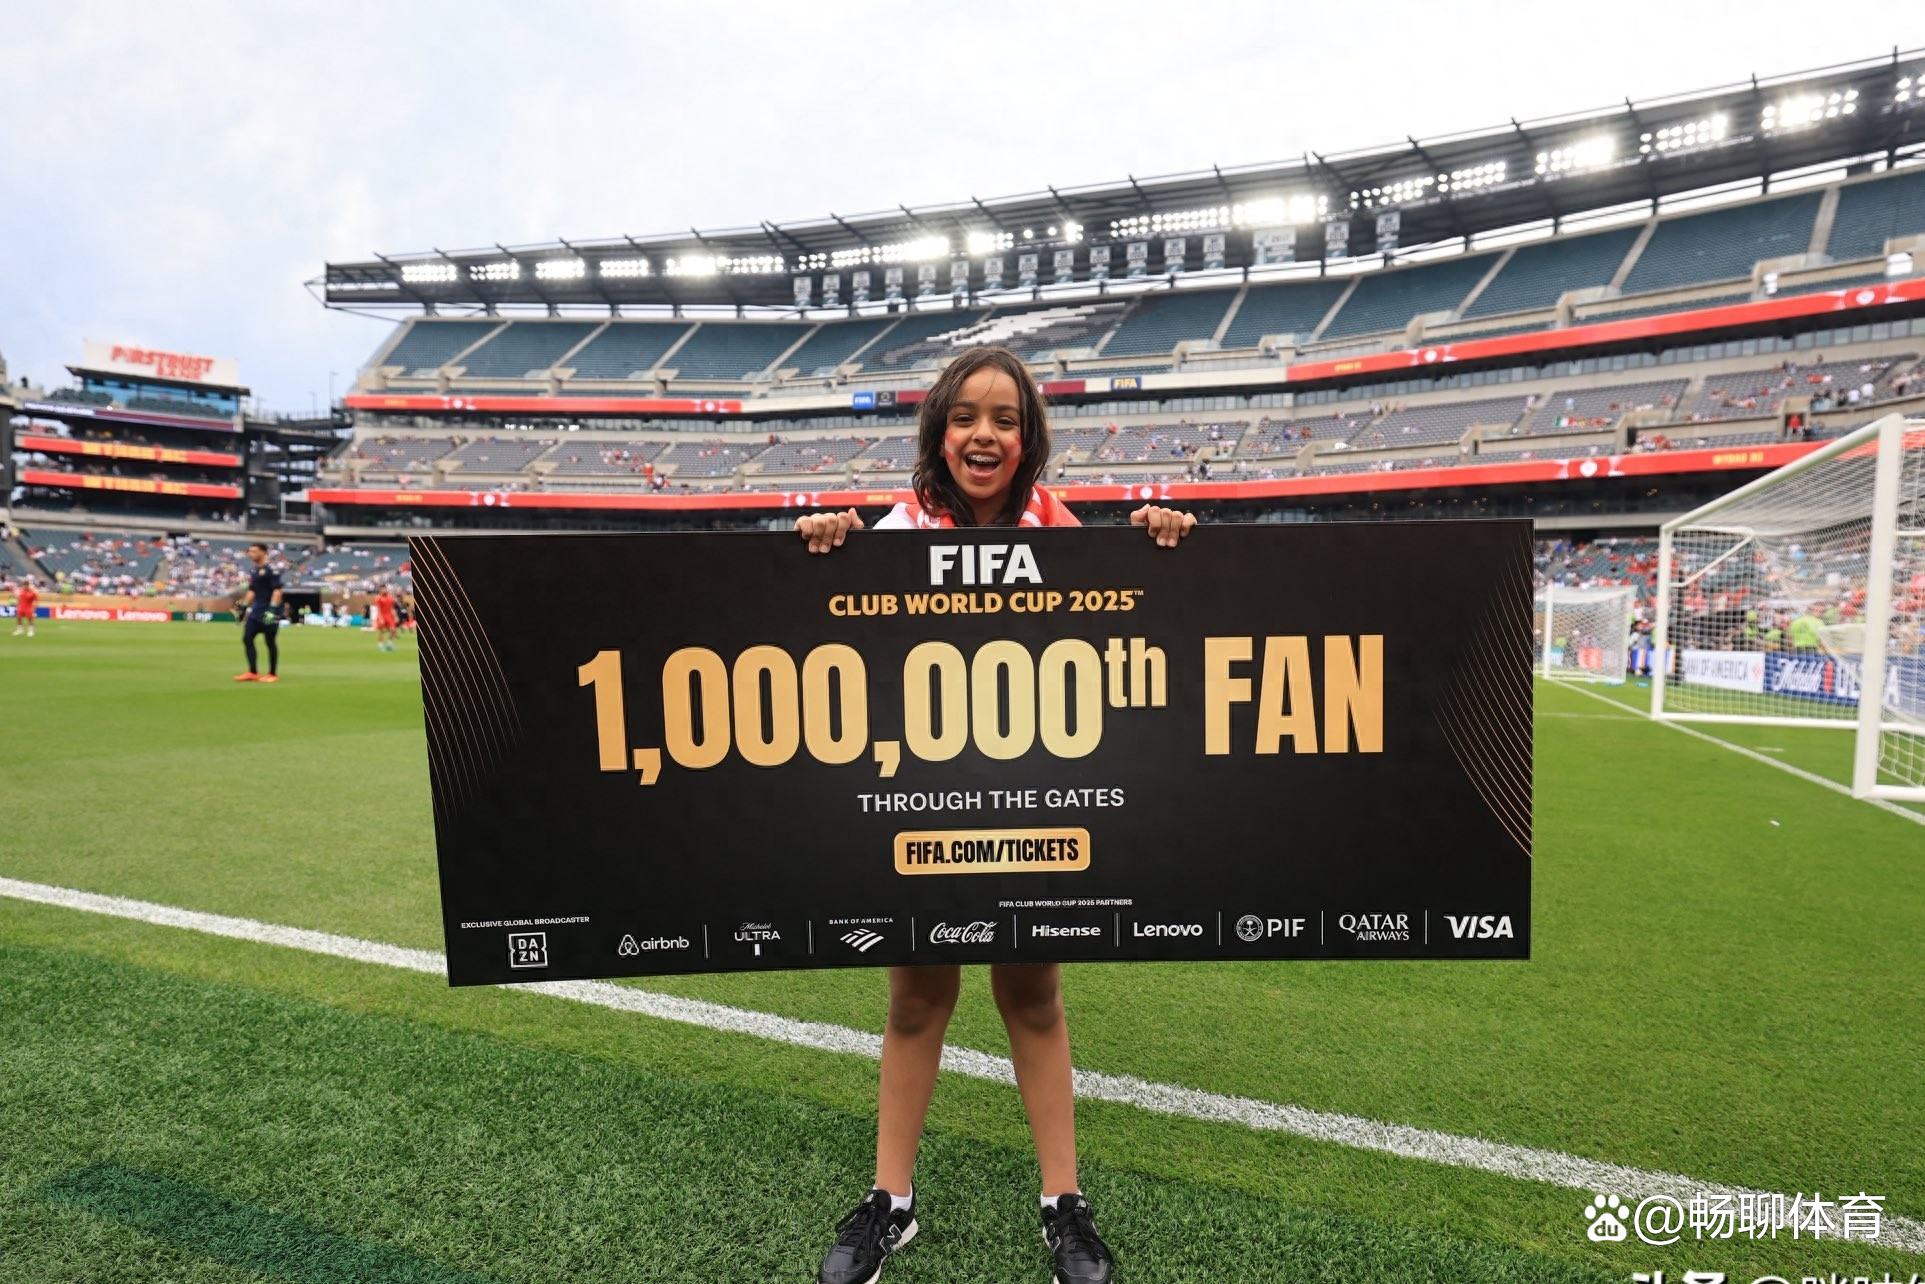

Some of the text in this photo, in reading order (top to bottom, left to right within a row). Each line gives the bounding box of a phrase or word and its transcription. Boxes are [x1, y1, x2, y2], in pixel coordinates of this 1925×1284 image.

[1114, 378, 1138, 390] FIFA
[930, 544, 1043, 586] FIFA
[829, 593, 899, 617] CLUB
[904, 592, 1003, 615] WORLD
[1009, 591, 1062, 613] CUP
[55, 607, 168, 622] Lenovo Lenovo
[578, 634, 1384, 786] 1,000,000th FAN
[857, 788, 1125, 812] THROUGH THE GATES
[906, 837, 1079, 865] FIFA.COM/TICKETS
[1095, 898, 1133, 906] PARTNERS
[461, 916, 590, 929] EXCLUSIVE GLOBAL BROADCASTER
[739, 922, 772, 931] Michelob
[1133, 922, 1203, 937] Lenovo
[1266, 918, 1306, 937] PIF
[1338, 914, 1410, 933] QATAR
[1443, 916, 1514, 939] VISA
[734, 930, 781, 942] ULTRA
[929, 921, 999, 944] Coca-Cola
[1031, 925, 1101, 937] Hisense
[1356, 931, 1410, 941] AIRWAYS
[640, 935, 690, 950] airbnb
